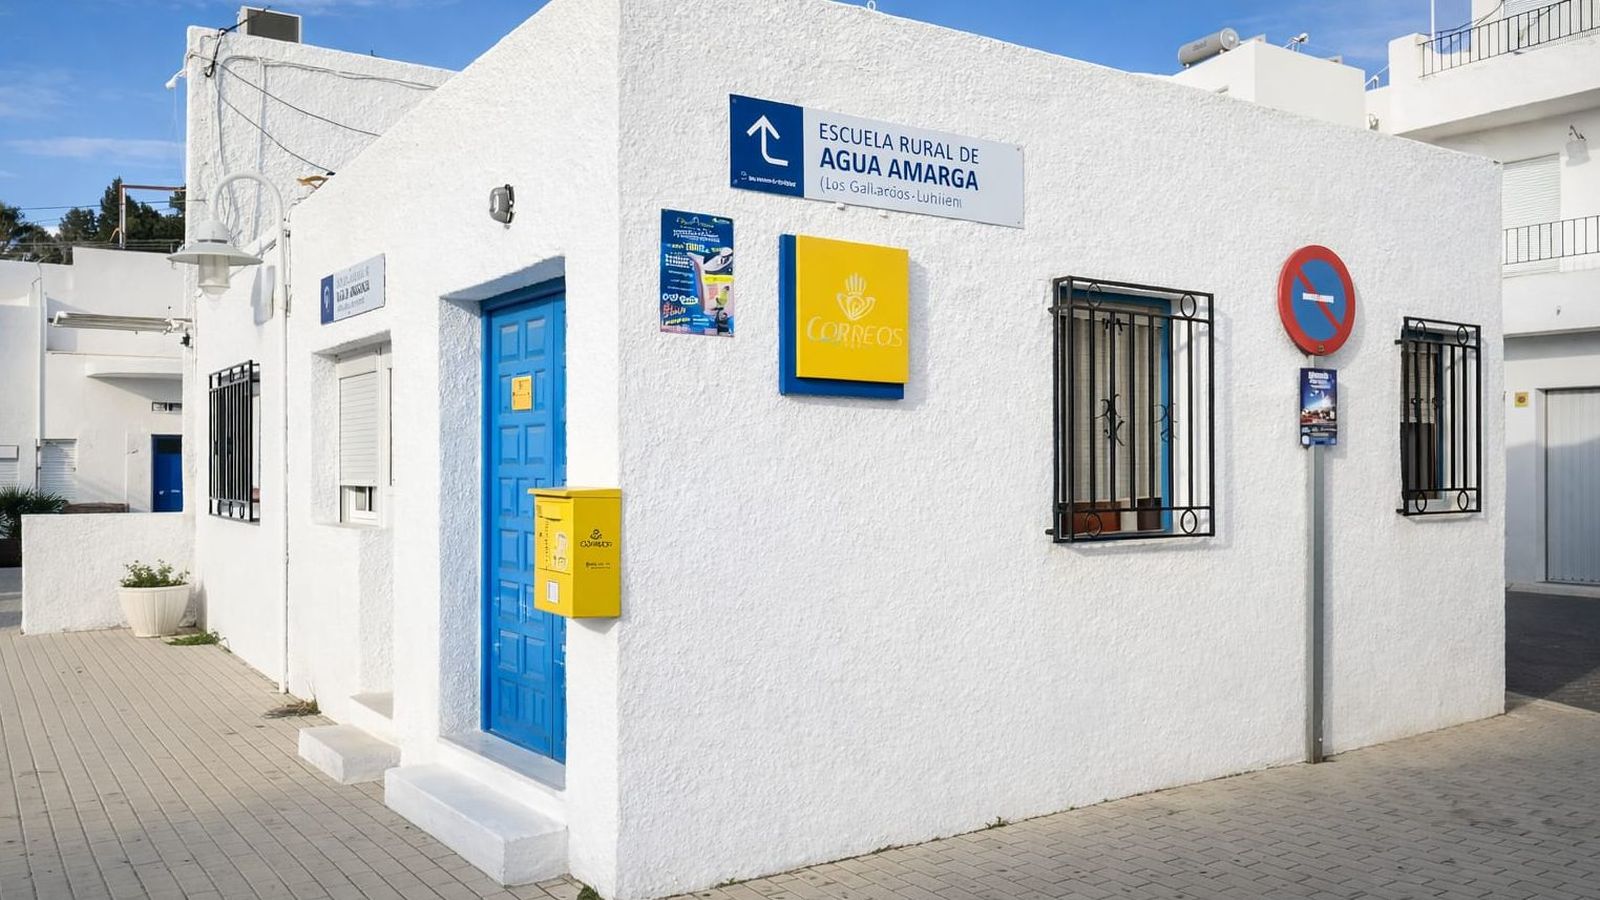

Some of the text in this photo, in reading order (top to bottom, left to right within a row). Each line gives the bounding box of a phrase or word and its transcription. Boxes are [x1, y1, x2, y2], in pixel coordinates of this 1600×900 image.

[819, 122, 979, 165] ESCUELA RURAL DE
[819, 147, 979, 191] AGUA AMARGA
[820, 175, 846, 194] (Los
